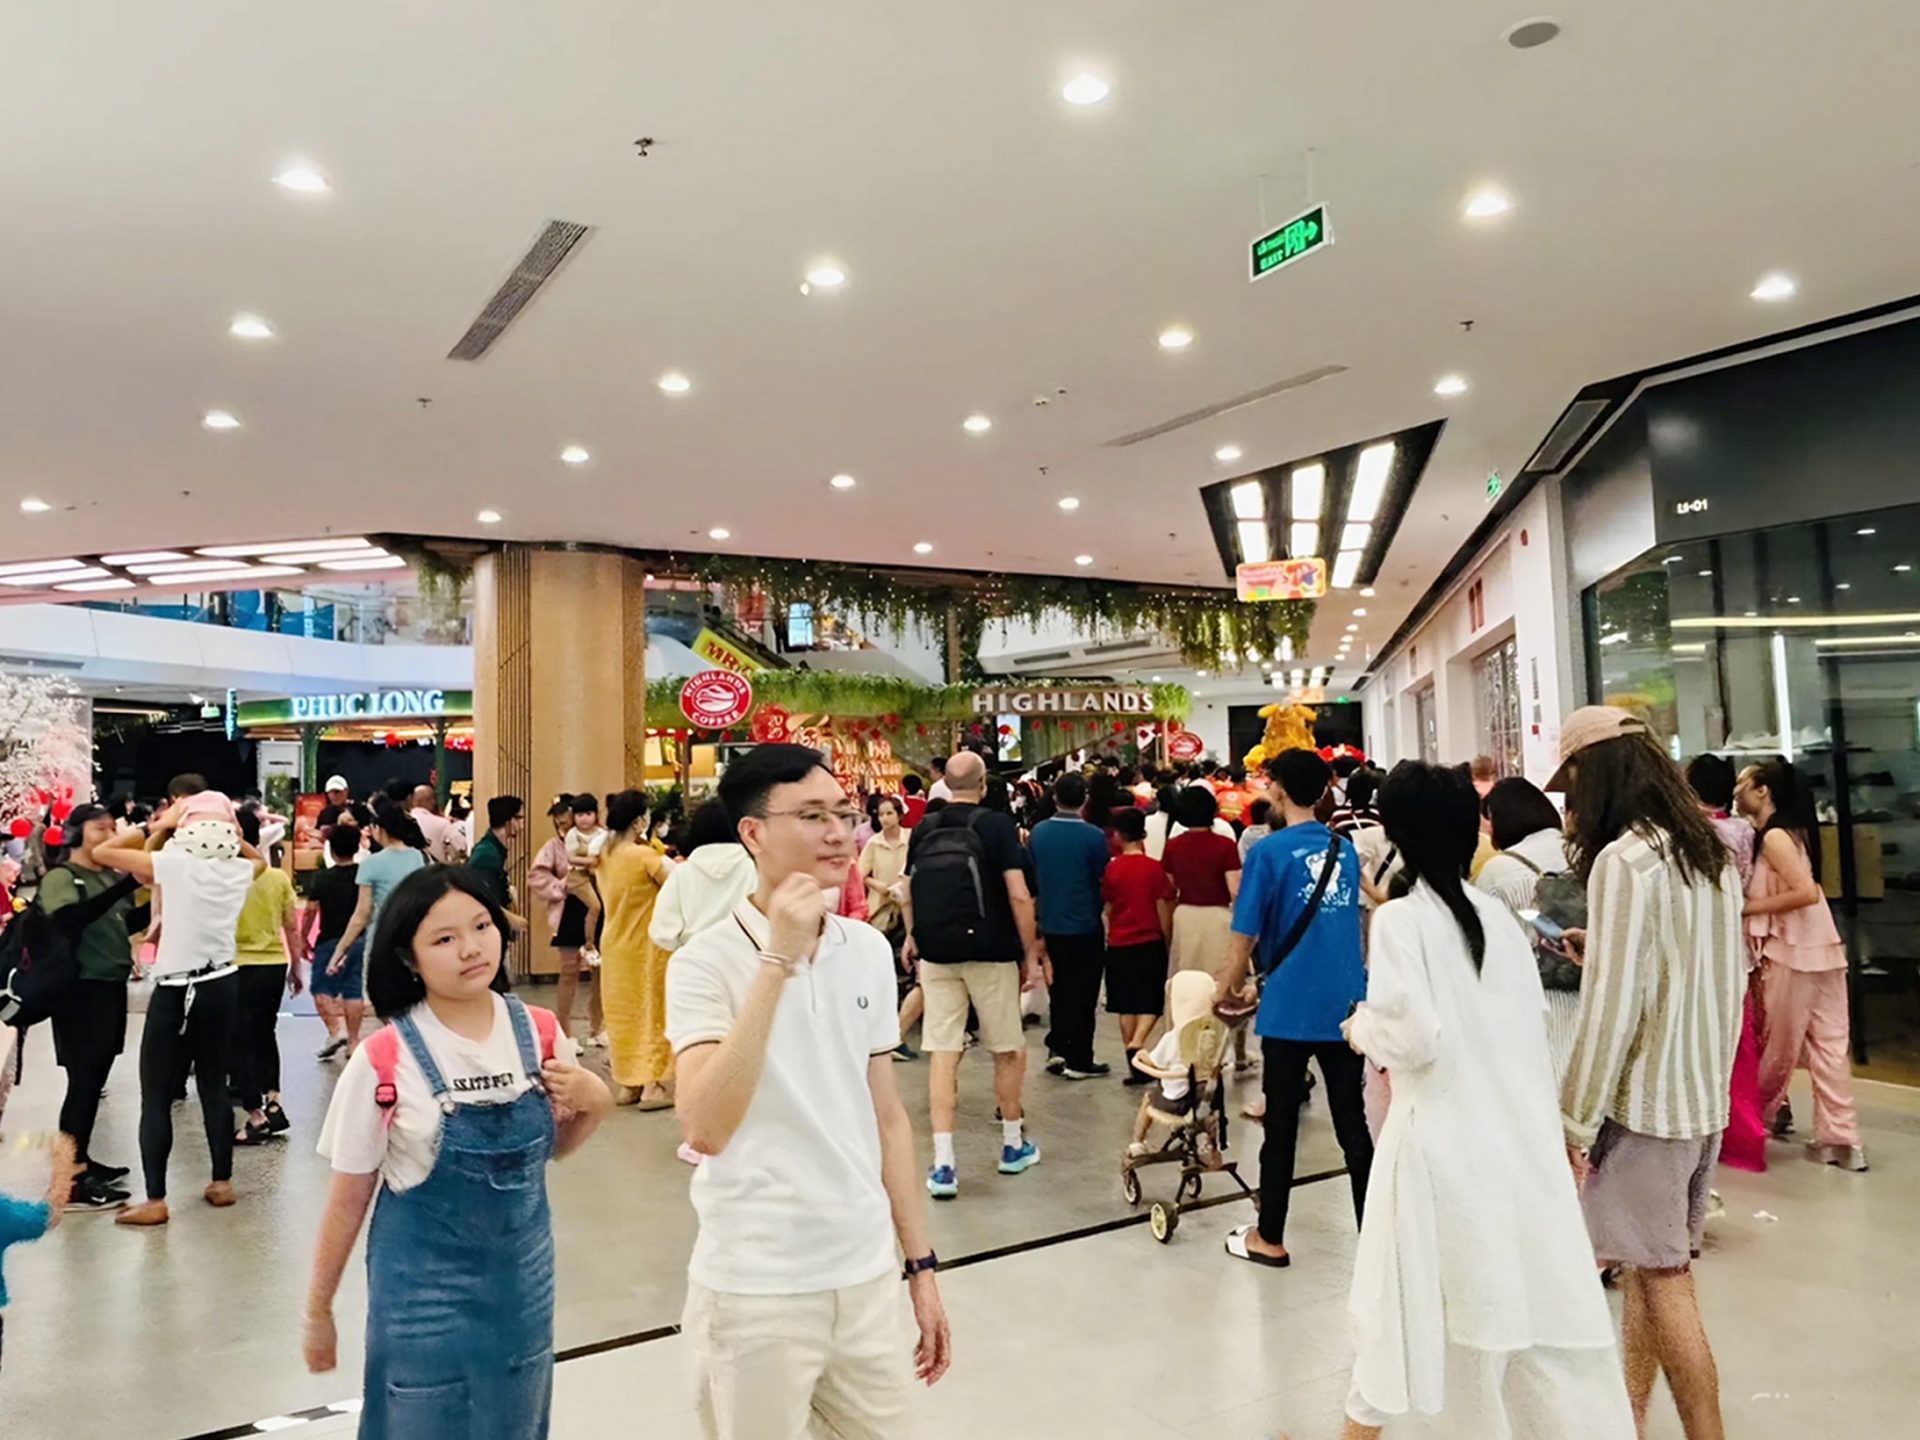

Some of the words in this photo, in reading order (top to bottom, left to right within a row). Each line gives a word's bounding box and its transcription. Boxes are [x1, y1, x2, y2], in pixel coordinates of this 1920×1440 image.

[684, 671, 747, 697] HIGHLANDS
[367, 689, 445, 715] LONG
[972, 691, 1154, 713] HIGHLANDS
[691, 709, 741, 725] COFFEE
